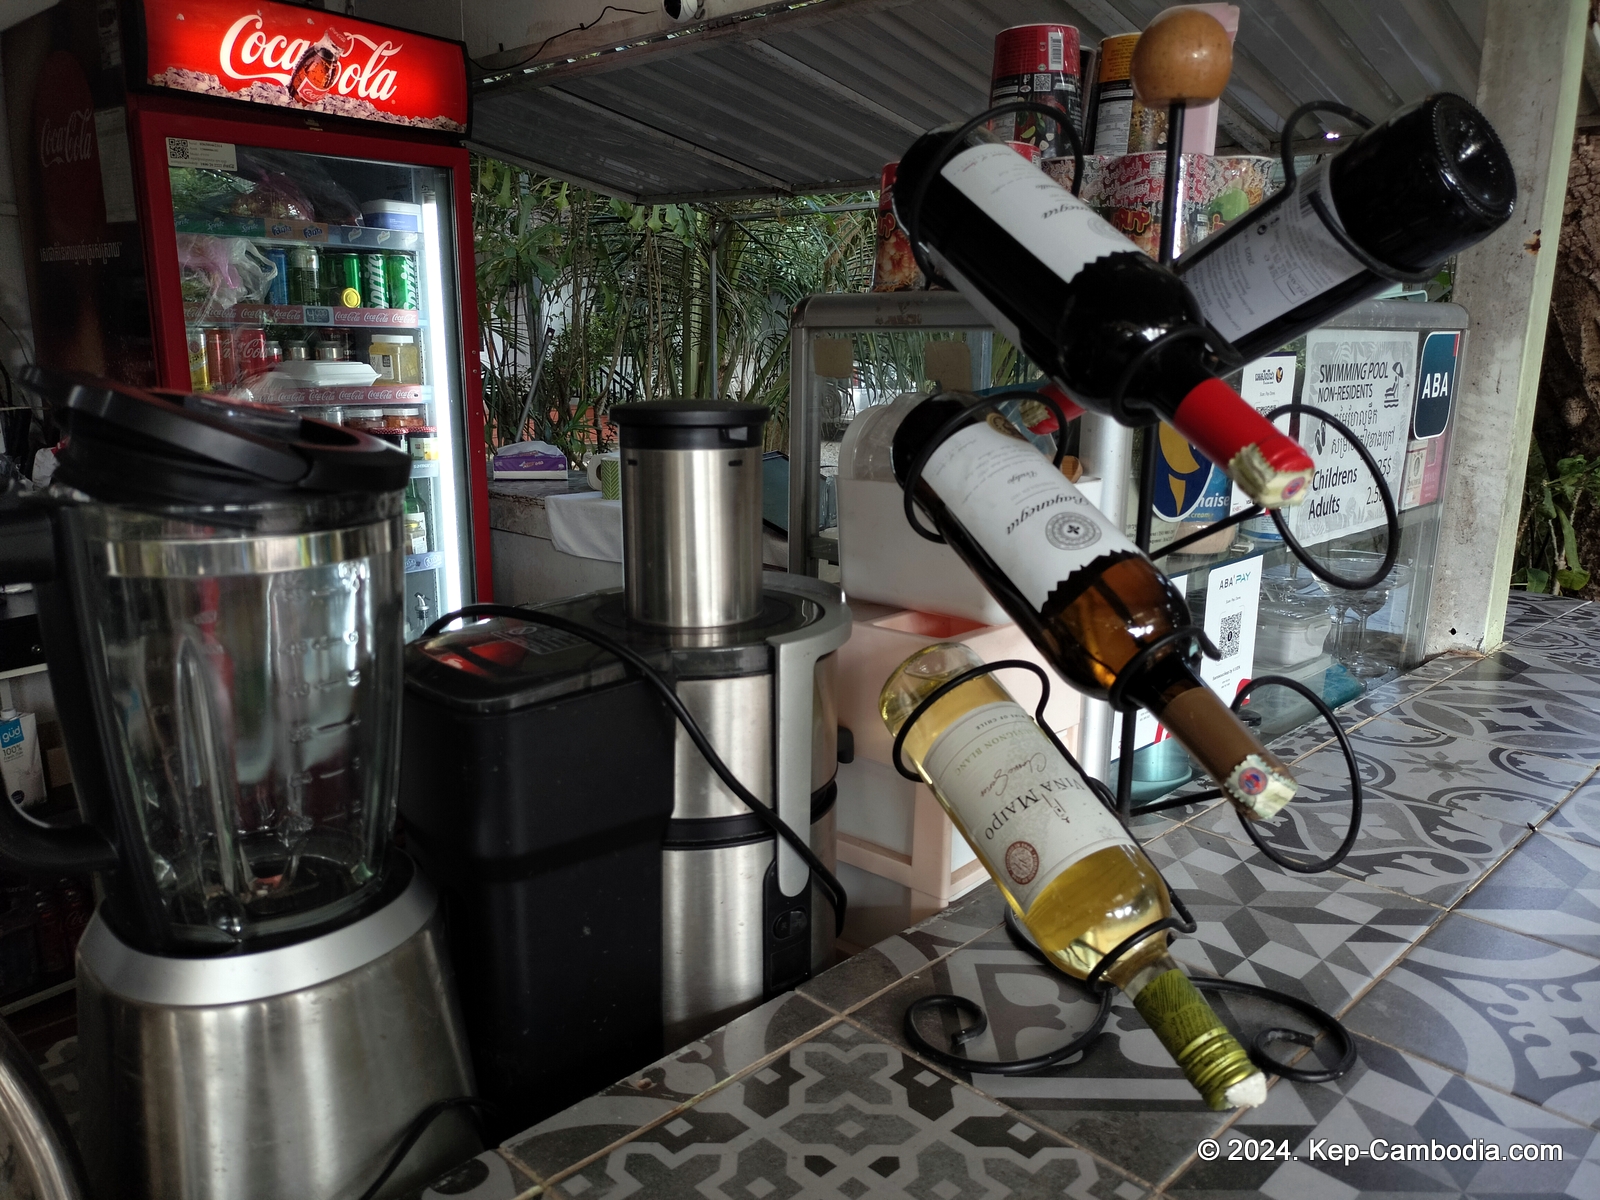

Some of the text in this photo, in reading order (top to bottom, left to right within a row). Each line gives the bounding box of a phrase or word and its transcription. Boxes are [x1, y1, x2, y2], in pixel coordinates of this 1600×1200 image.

[220, 14, 403, 101] Cocaola
[271, 224, 292, 236] Fanta
[302, 227, 323, 239] Fanta
[1319, 361, 1389, 383] SWIMMING POOL
[1317, 383, 1373, 403] NON-RESIDENTS
[1421, 372, 1448, 399] ABA
[1312, 466, 1357, 492] Childrens
[1195, 492, 1230, 509] naise
[1308, 495, 1340, 520] Adults
[2, 725, 21, 744] güd
[976, 718, 997, 730] CHILE
[1008, 752, 1047, 774] Classic
